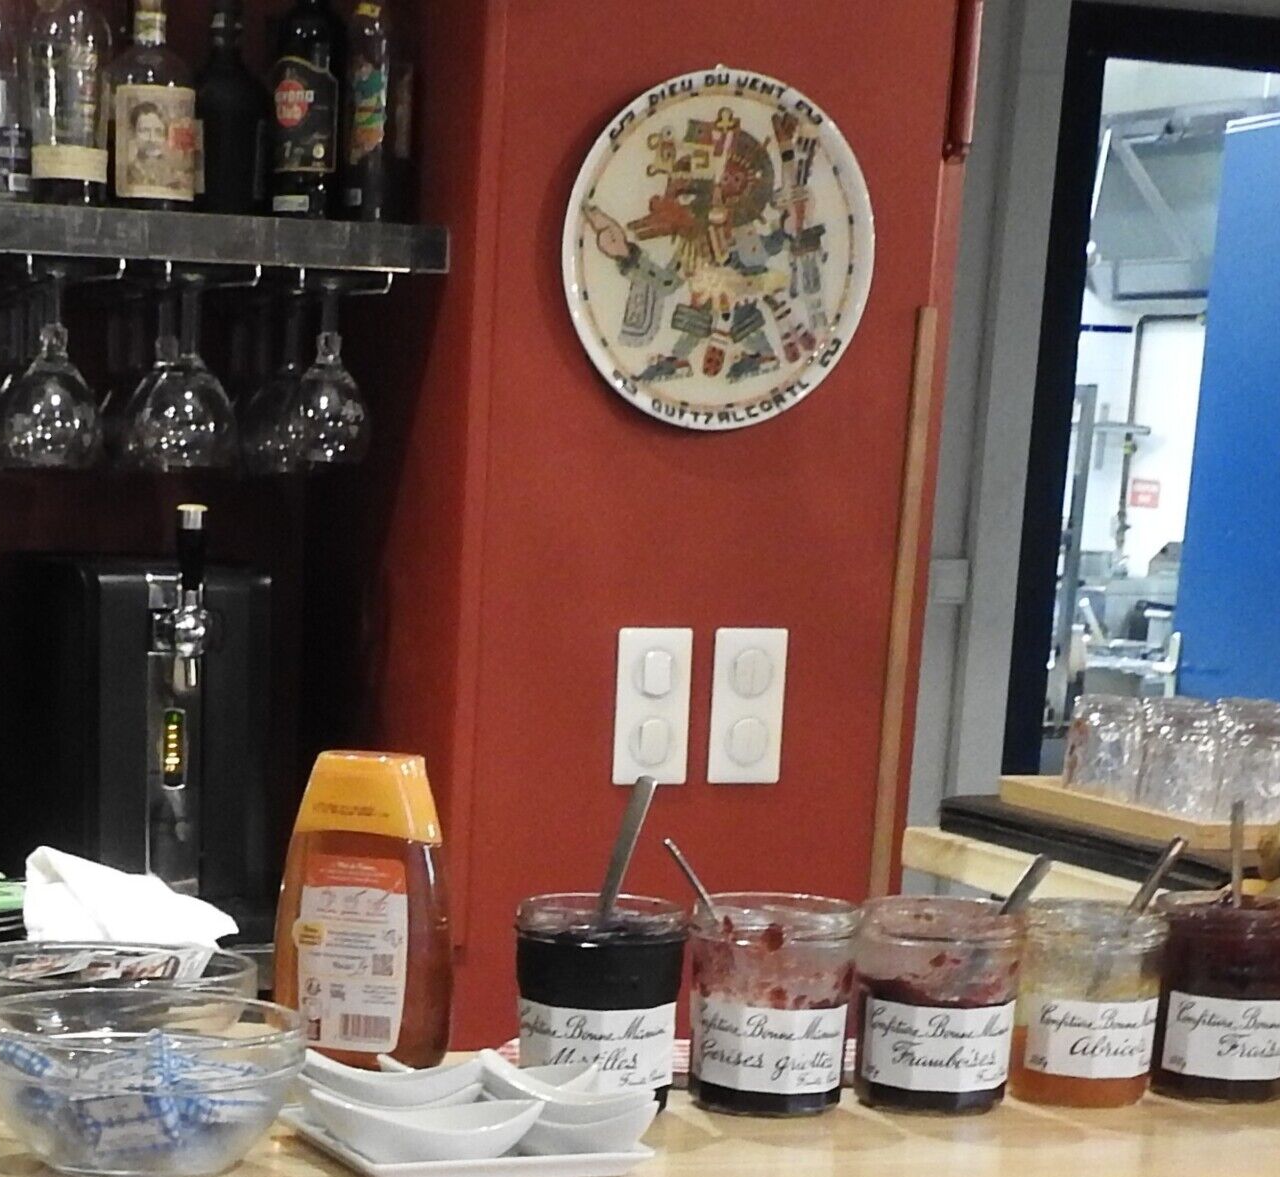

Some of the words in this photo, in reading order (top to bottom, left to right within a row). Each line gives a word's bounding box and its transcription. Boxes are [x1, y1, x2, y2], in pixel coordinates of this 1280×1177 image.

[648, 78, 693, 107] DIEU
[704, 73, 730, 87] DU
[736, 75, 788, 99] VENT
